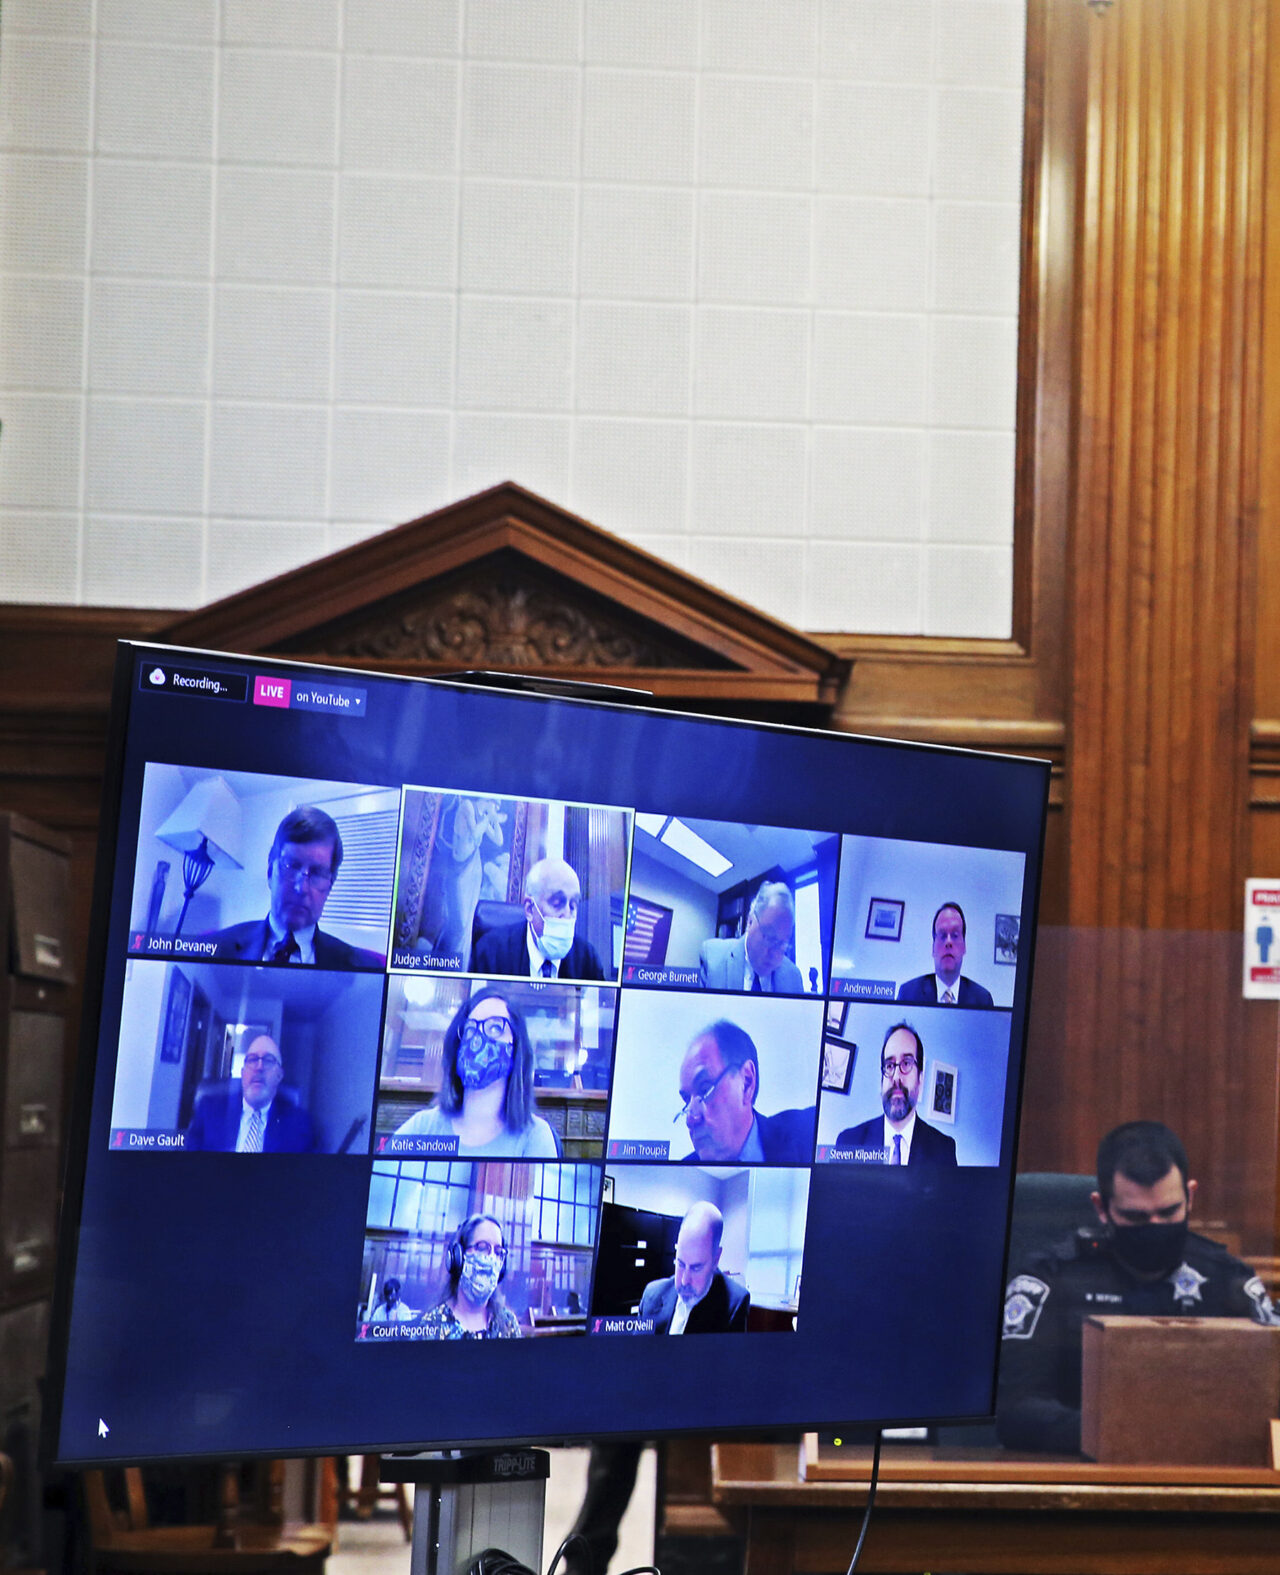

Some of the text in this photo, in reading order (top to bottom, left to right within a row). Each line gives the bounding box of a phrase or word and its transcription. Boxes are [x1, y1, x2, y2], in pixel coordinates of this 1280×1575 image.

[260, 684, 350, 707] LIVE on YouTube
[148, 937, 217, 956] John Devaney
[393, 953, 460, 969] Judge Simanek
[638, 969, 698, 984] George Burnett
[843, 982, 893, 996] Andrew Jones
[129, 1133, 184, 1147] Dave Gault
[391, 1138, 456, 1152] Katie Sandoval
[622, 1143, 667, 1158] Jim Troupis
[829, 1148, 889, 1163] Steven Kilpatrick
[372, 1325, 438, 1339] Court Reporter
[605, 1319, 653, 1332] Matt O'Neill
